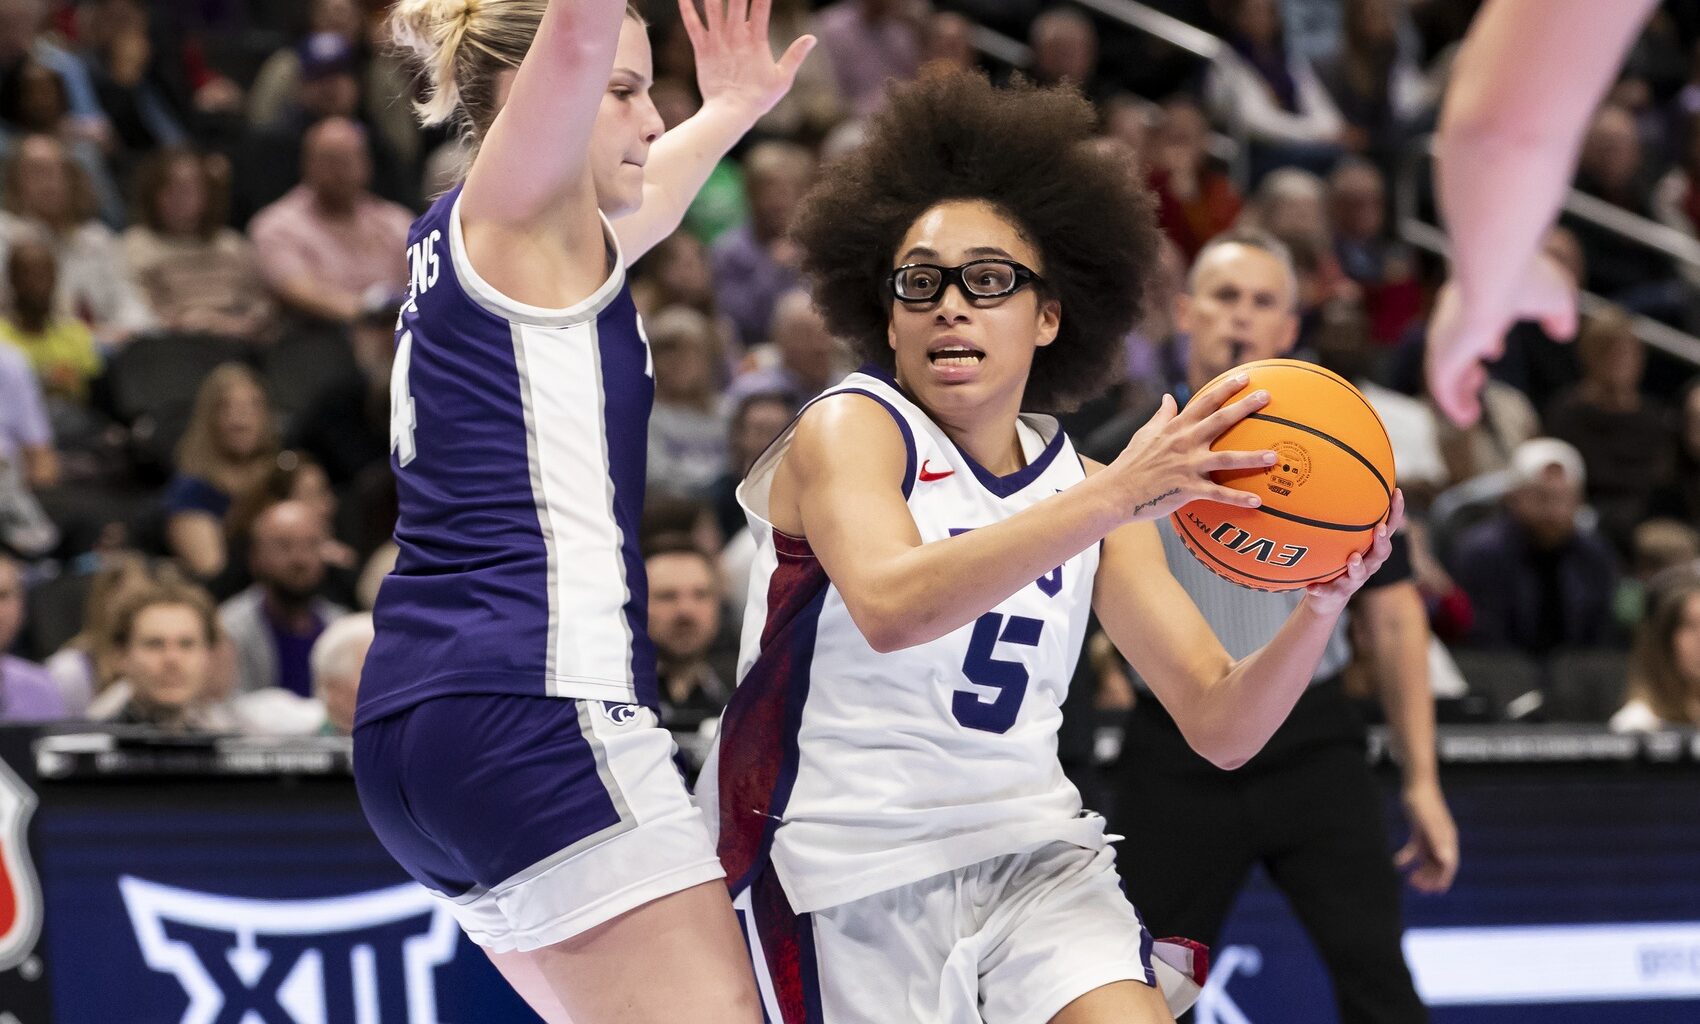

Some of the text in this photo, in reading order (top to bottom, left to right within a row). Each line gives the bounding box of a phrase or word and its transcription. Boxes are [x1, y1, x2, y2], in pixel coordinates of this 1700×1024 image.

[1186, 511, 1211, 534] NXT
[1209, 522, 1308, 568] EVO
[951, 611, 1045, 735] 5
